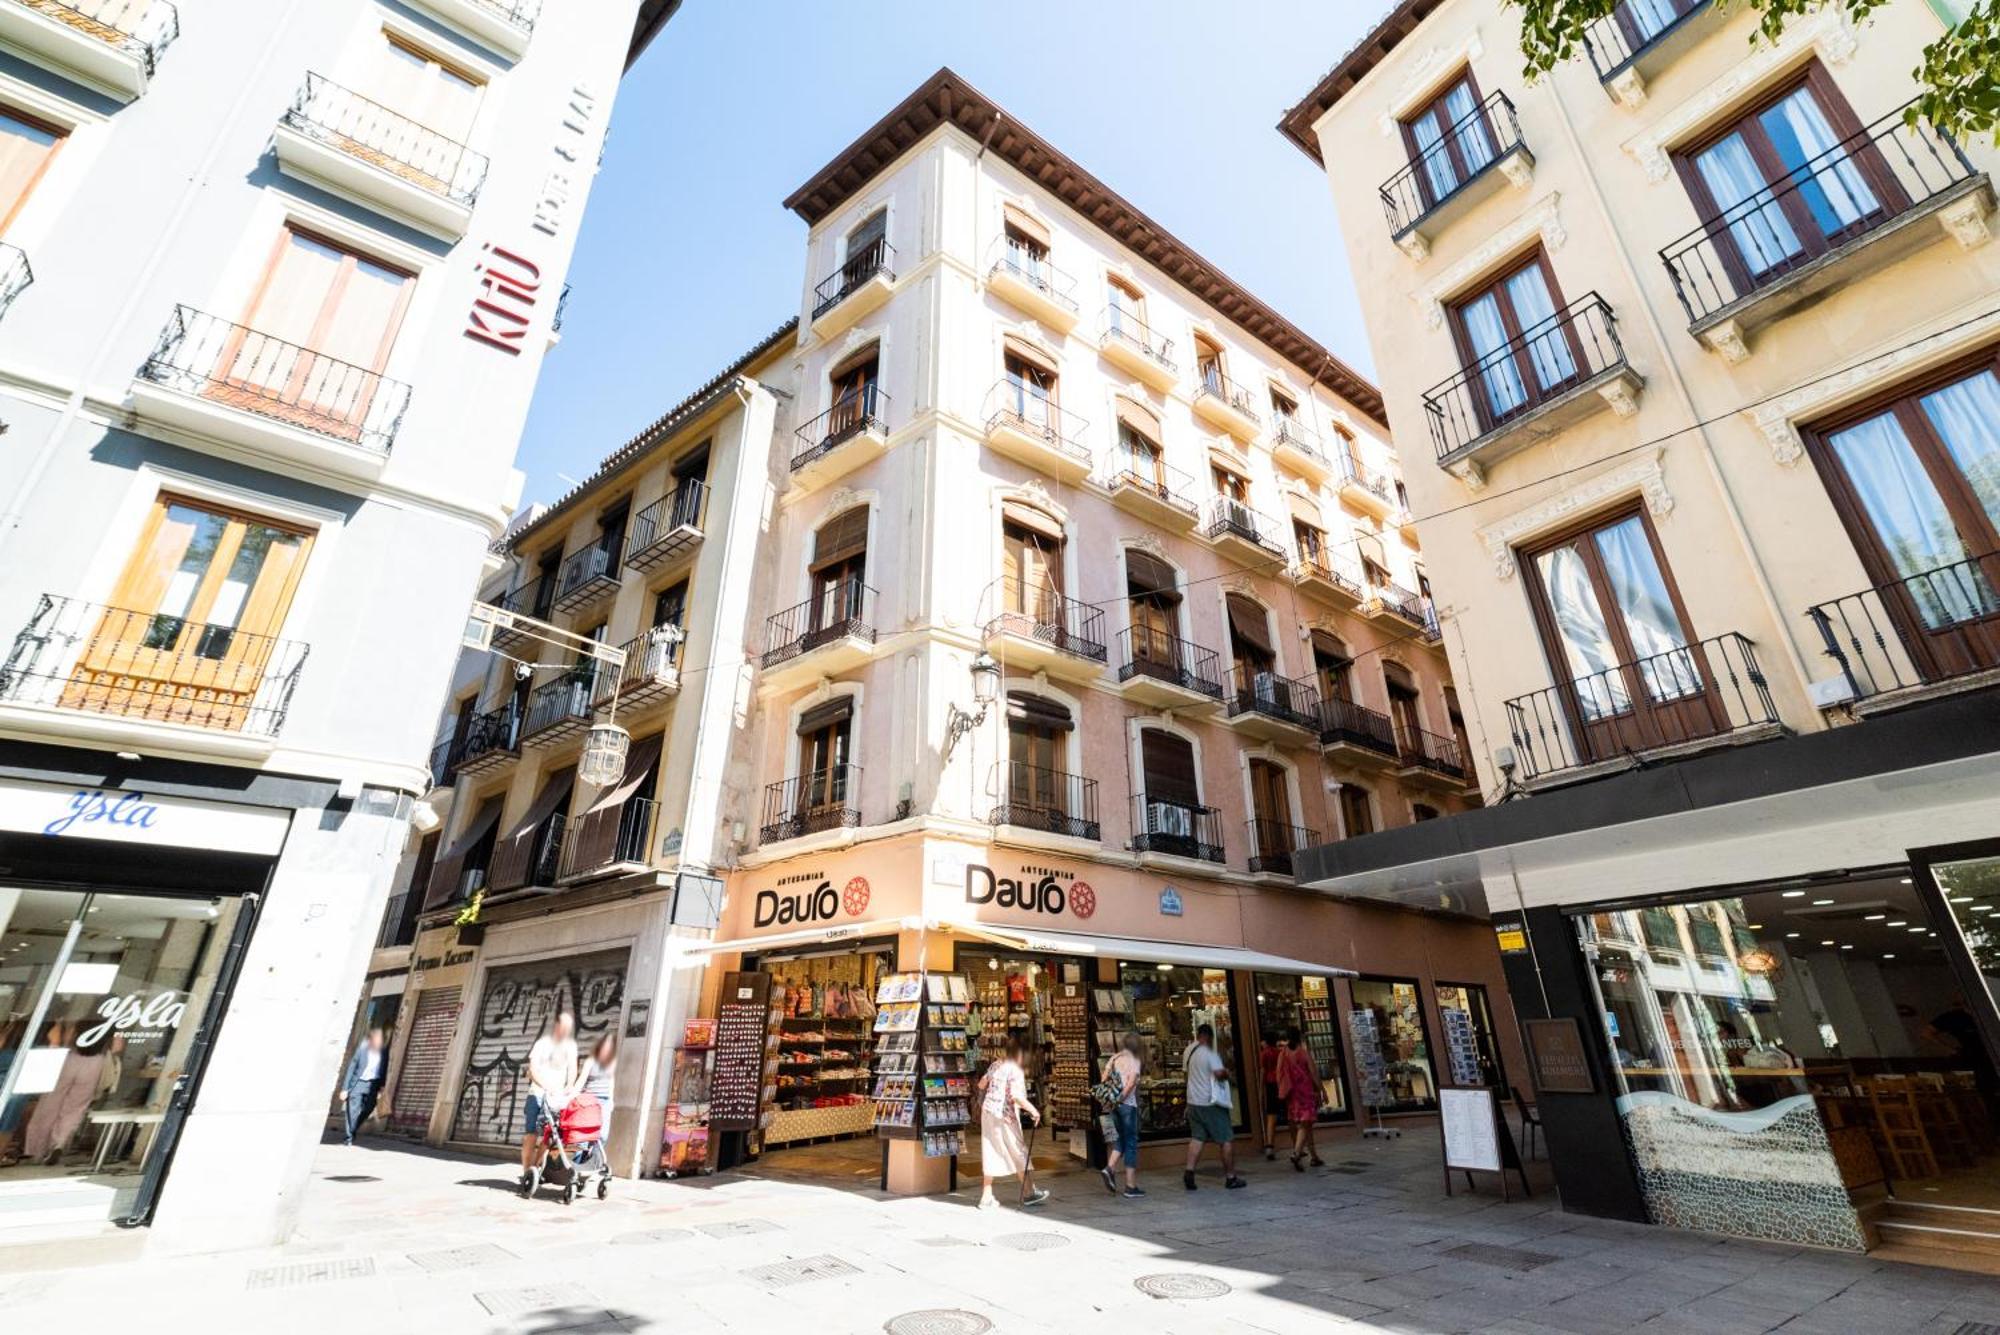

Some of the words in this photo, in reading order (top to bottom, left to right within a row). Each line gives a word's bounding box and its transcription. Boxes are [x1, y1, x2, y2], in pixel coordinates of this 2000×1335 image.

[43, 790, 159, 838] ysla
[754, 880, 839, 928] Dauro
[965, 863, 1066, 915] Dauro
[75, 990, 186, 1047] ysla
